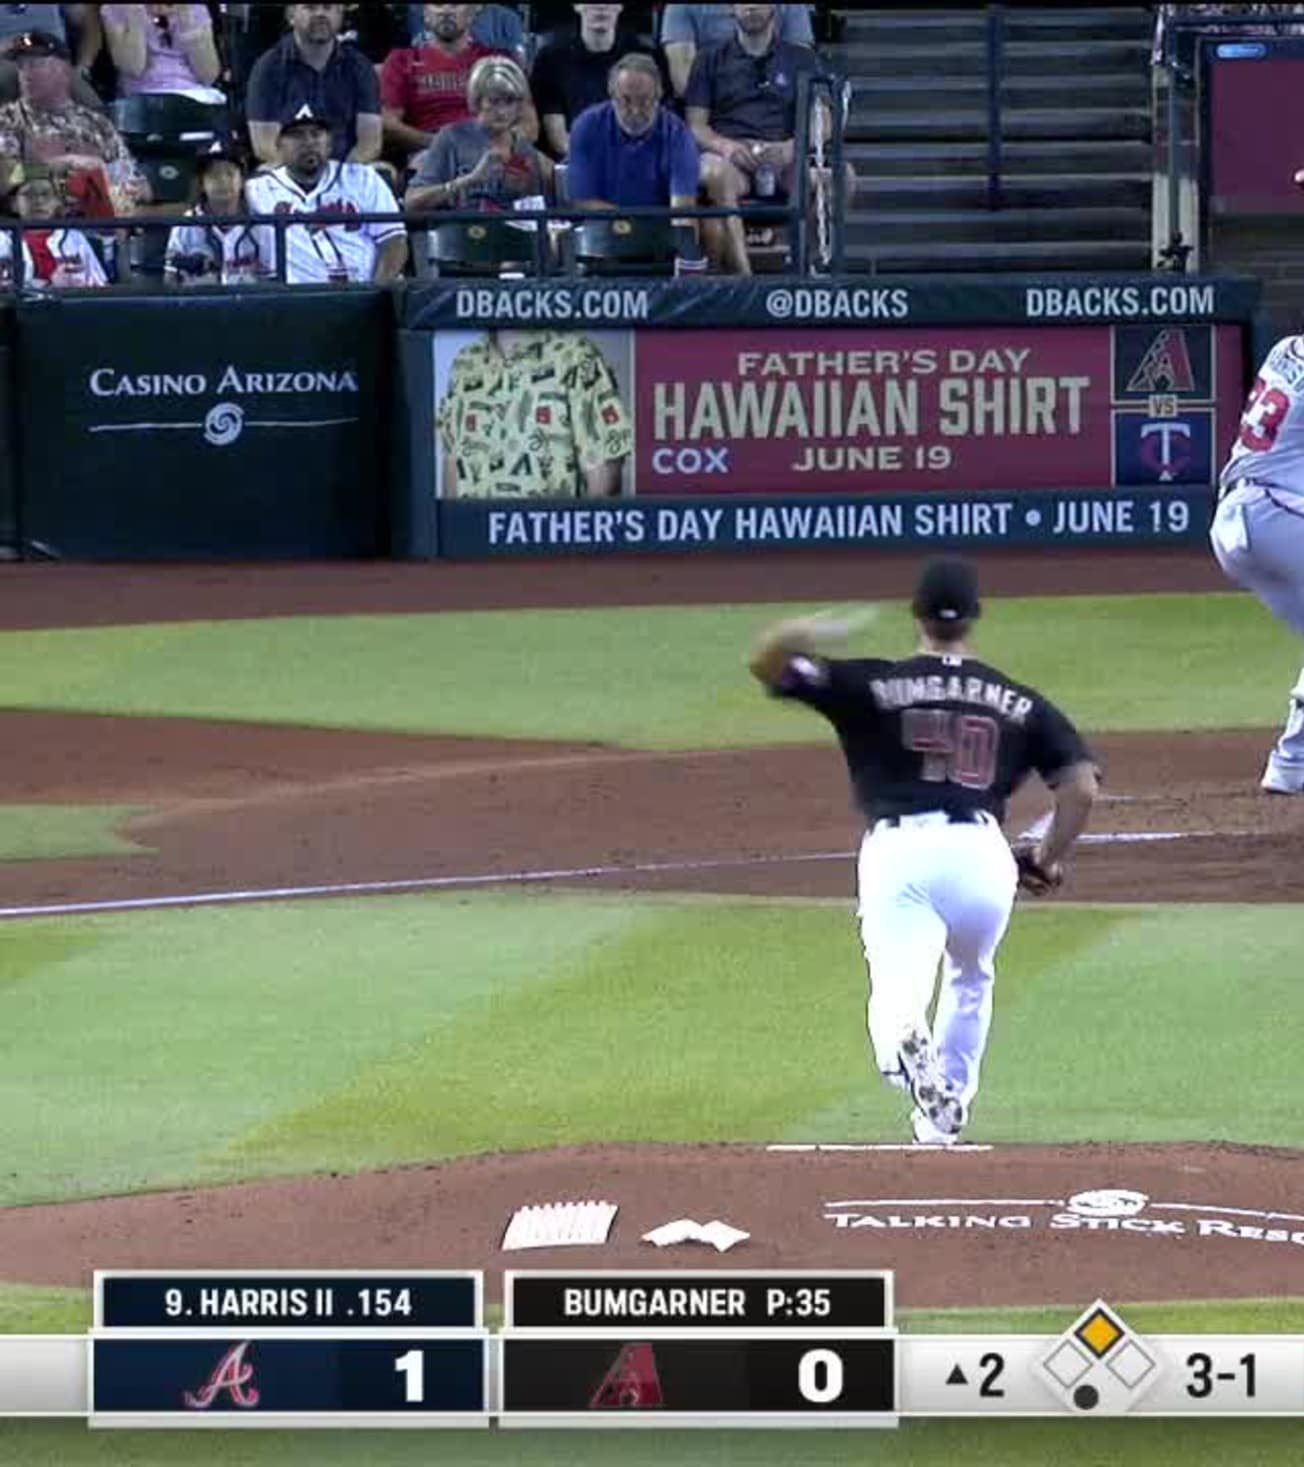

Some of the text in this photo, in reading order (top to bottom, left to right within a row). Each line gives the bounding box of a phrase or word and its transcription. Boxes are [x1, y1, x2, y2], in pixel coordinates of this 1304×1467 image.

[456, 289, 648, 319] DBACKS.COM
[765, 288, 909, 319] @DBACKS
[1026, 285, 1215, 317] DBACKS.COM
[737, 348, 1031, 377] FATHER'S DAY
[653, 376, 1091, 441] HAWAIIAN SHIRT
[652, 447, 729, 475] COX
[791, 445, 953, 473] JUNE 19
[488, 500, 1190, 544] FATHER'S DAY HAWAIIAN SHIRT JUNE 19
